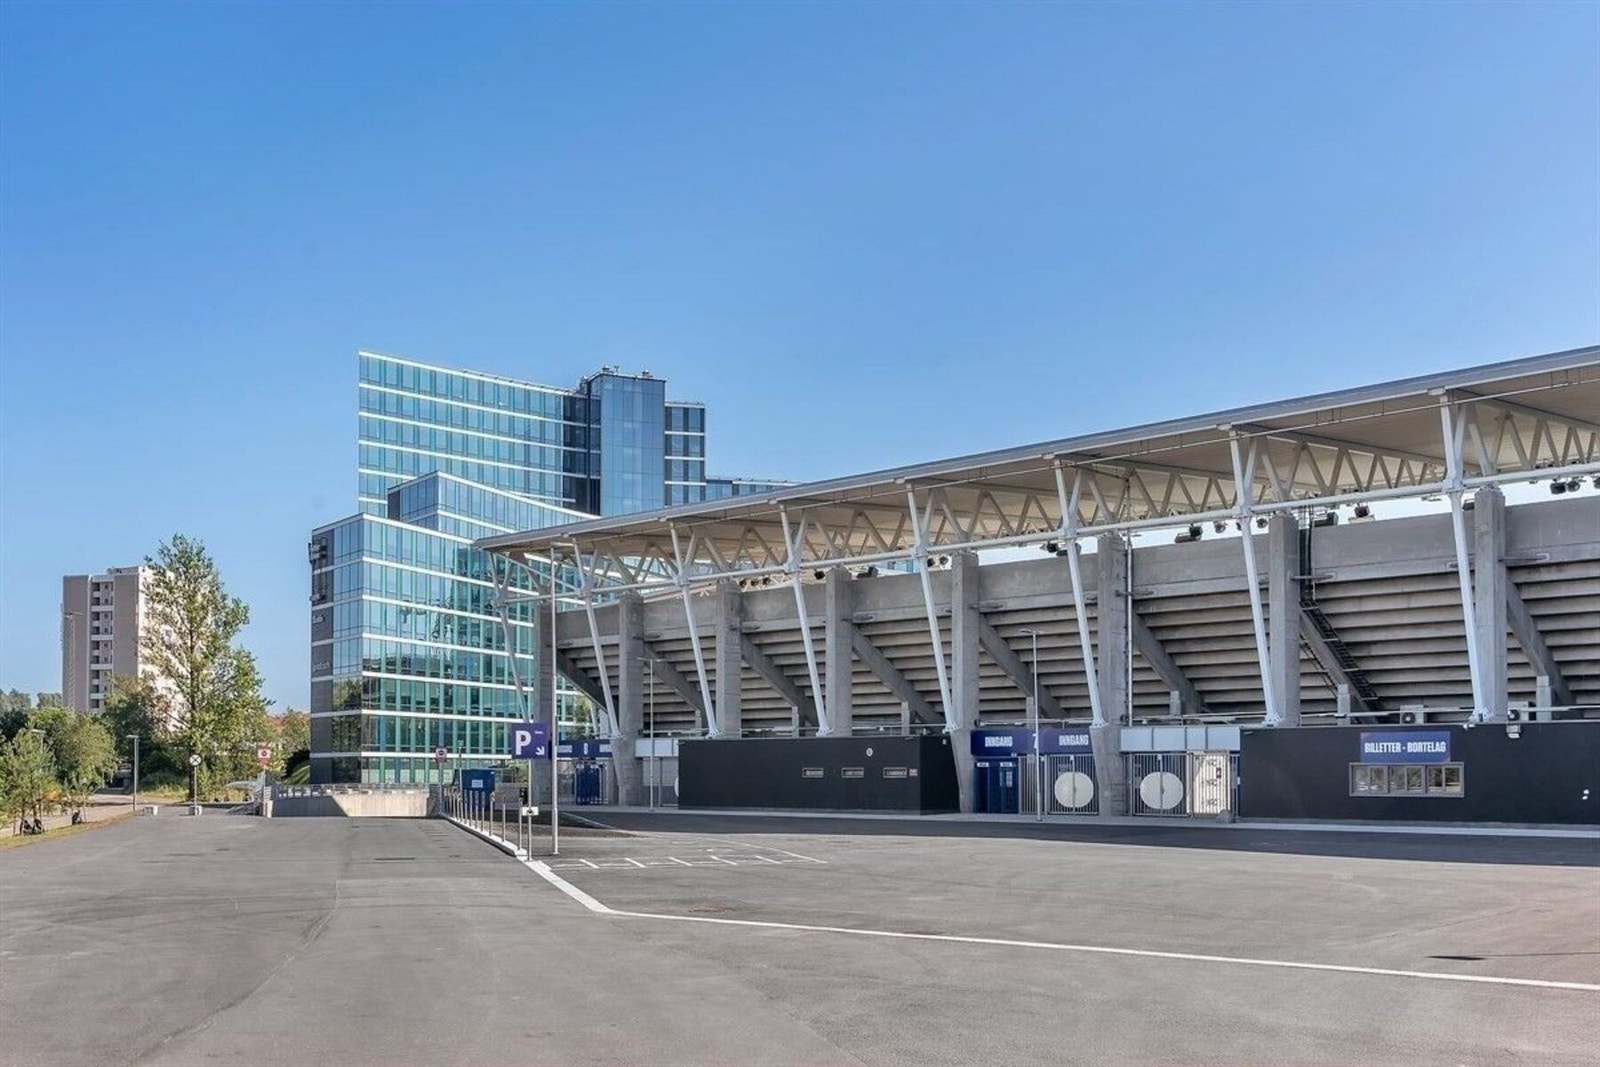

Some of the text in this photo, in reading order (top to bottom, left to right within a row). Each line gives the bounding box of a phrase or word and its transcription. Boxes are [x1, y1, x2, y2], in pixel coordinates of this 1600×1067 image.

[515, 730, 532, 756] P
[1364, 742, 1401, 753] BILLETTER
[1407, 741, 1447, 753] BORTELAG
